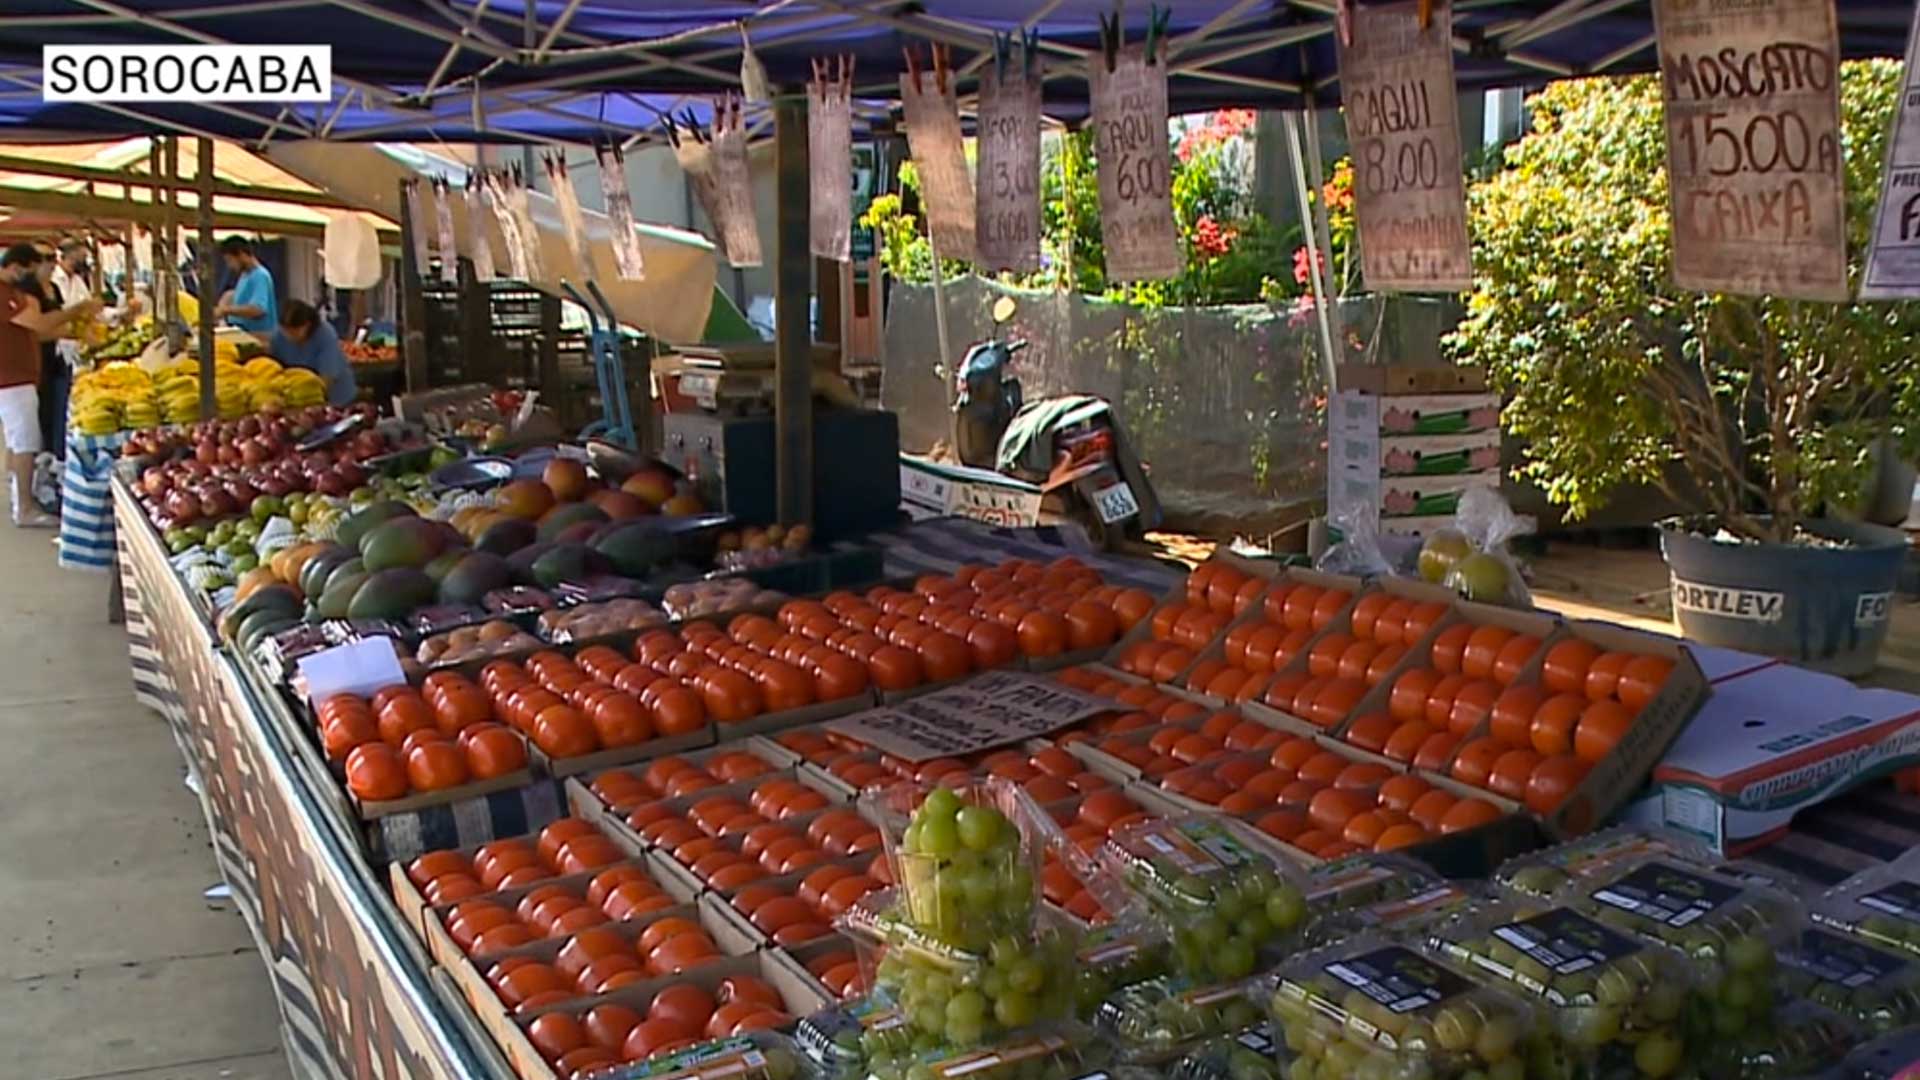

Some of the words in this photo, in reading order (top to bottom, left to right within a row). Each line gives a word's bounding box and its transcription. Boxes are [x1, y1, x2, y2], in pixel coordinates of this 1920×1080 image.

[1667, 42, 1832, 101] MOSCATO
[1351, 80, 1430, 137] CAQUI
[1117, 155, 1165, 206] 6,00
[1366, 136, 1437, 196] 8,00
[1675, 584, 1779, 616] ORTLEV
